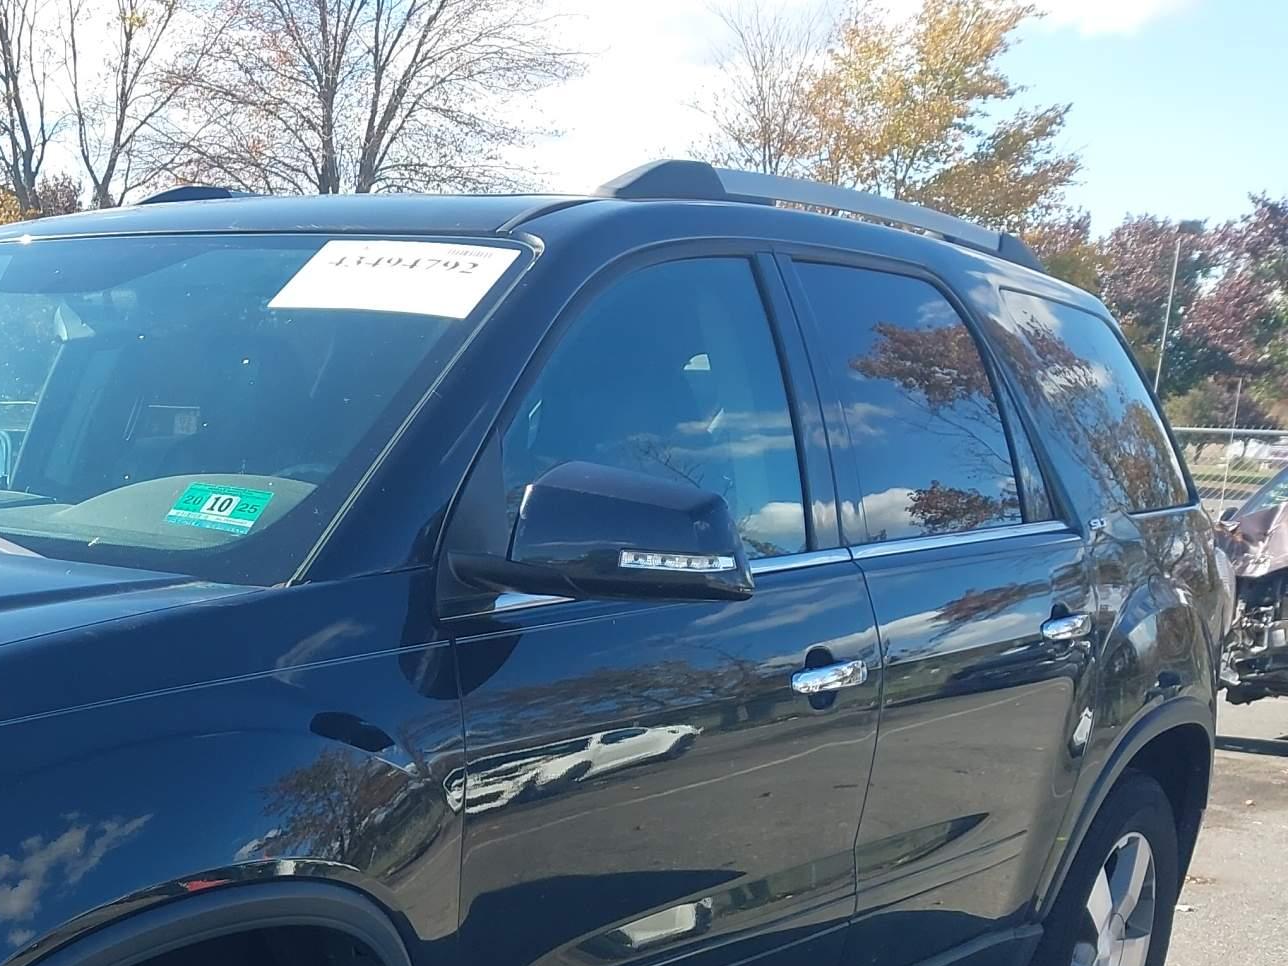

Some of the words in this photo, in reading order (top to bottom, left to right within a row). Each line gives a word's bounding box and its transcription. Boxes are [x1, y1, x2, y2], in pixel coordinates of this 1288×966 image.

[183, 495, 204, 506] 20
[206, 496, 234, 513] 10
[236, 502, 261, 514] 25
